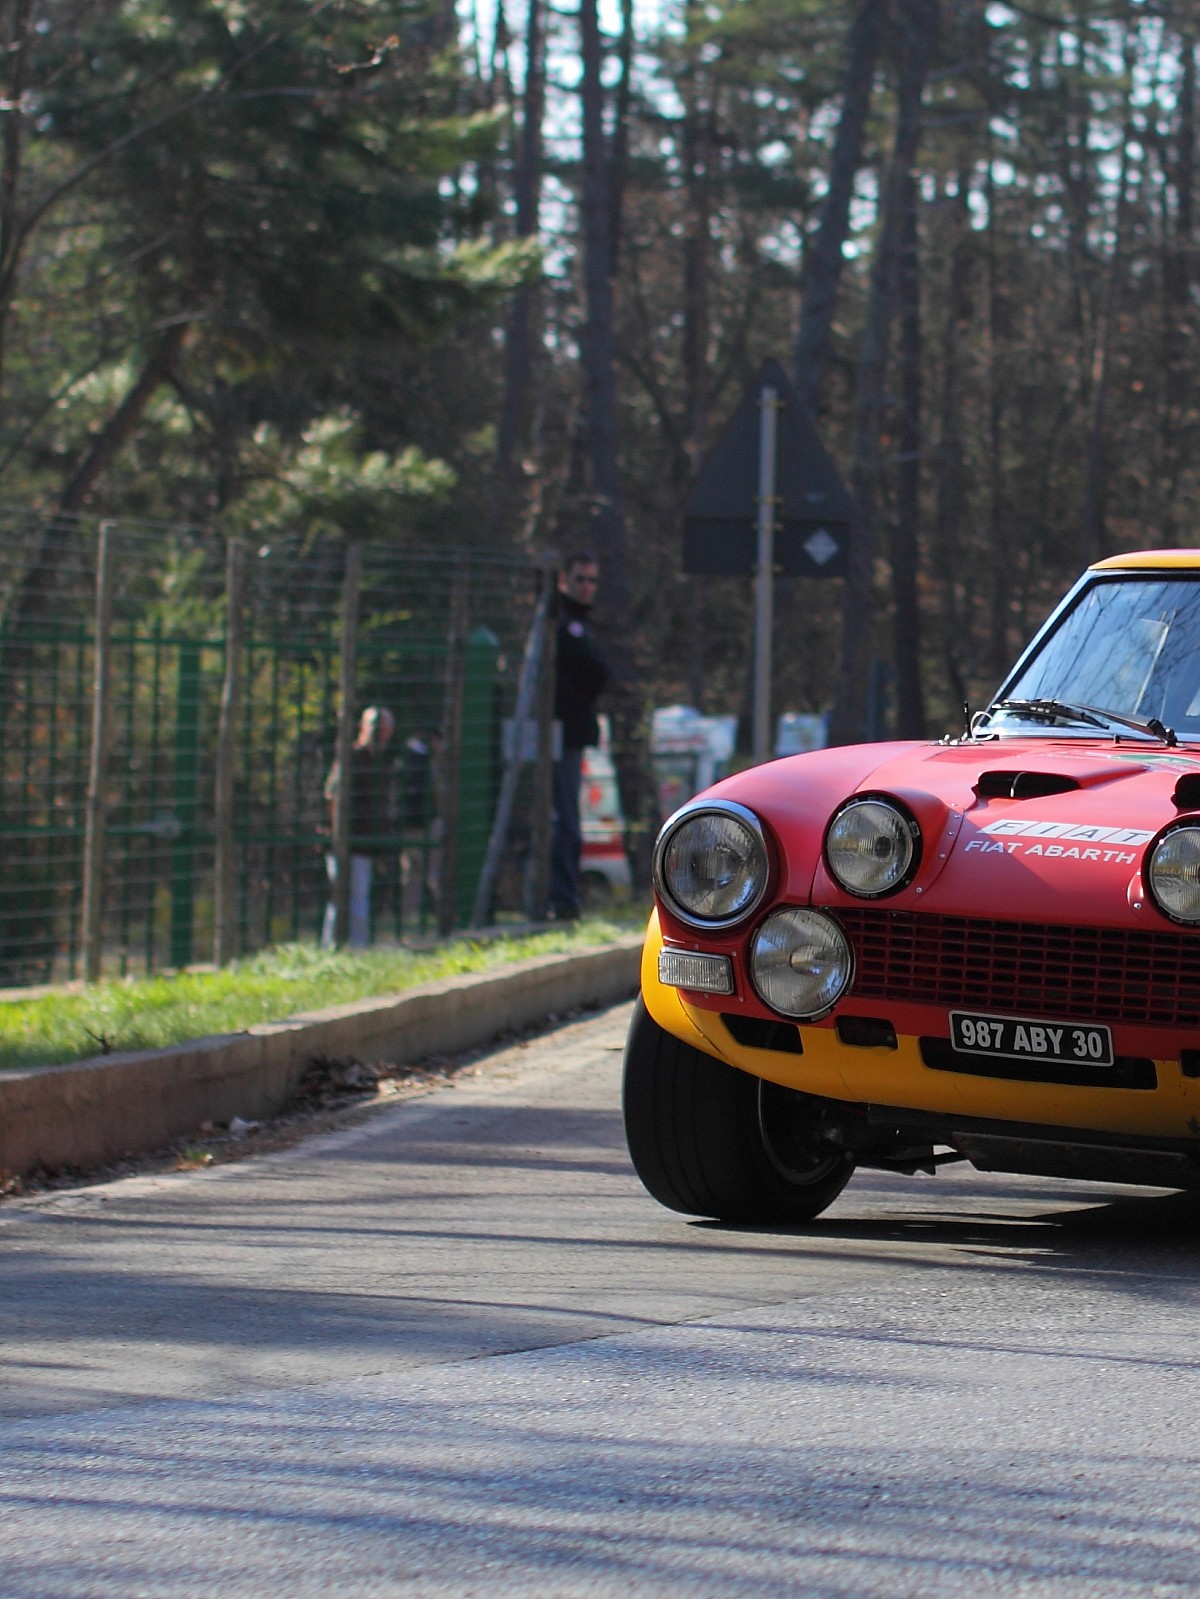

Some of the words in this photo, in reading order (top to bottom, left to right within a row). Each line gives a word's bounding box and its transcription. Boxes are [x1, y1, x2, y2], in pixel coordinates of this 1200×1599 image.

[993, 822, 1148, 842] FIAT
[965, 840, 1024, 854] FIAT
[1025, 844, 1137, 864] ABARTH
[961, 1019, 1004, 1049] 987
[1013, 1025, 1064, 1054] ABY
[1072, 1030, 1103, 1058] 30
